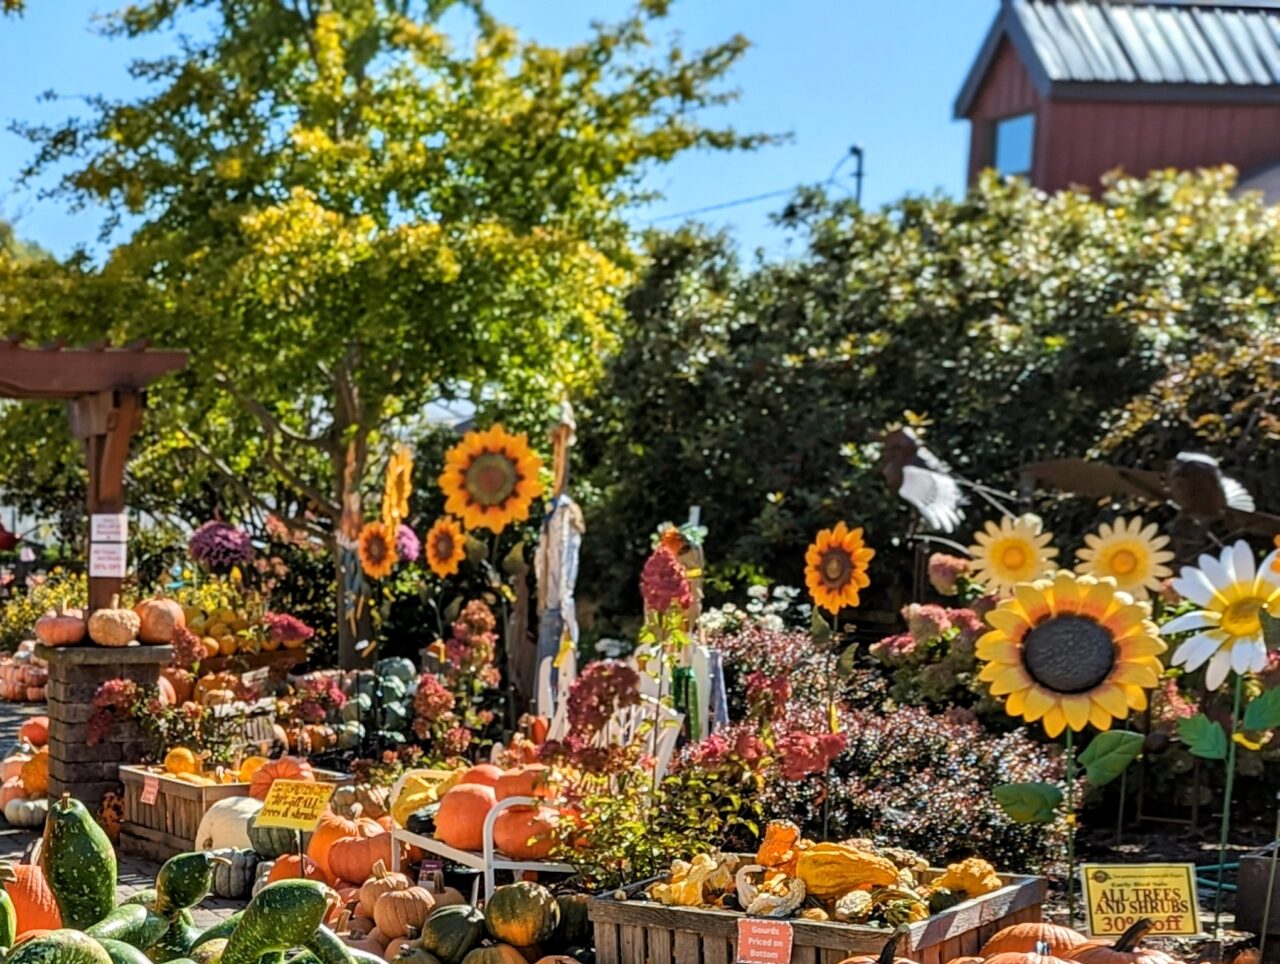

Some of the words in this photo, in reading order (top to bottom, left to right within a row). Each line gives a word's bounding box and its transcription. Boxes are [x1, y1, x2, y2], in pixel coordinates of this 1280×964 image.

[1099, 888, 1130, 902] ALL
[1132, 888, 1182, 901] TREES
[1095, 901, 1126, 914] AND
[1129, 900, 1189, 914] SHRUBS
[1153, 915, 1184, 931] off
[751, 925, 780, 936] Gourds
[748, 937, 772, 947] Priced
[750, 949, 779, 959] Bottom
